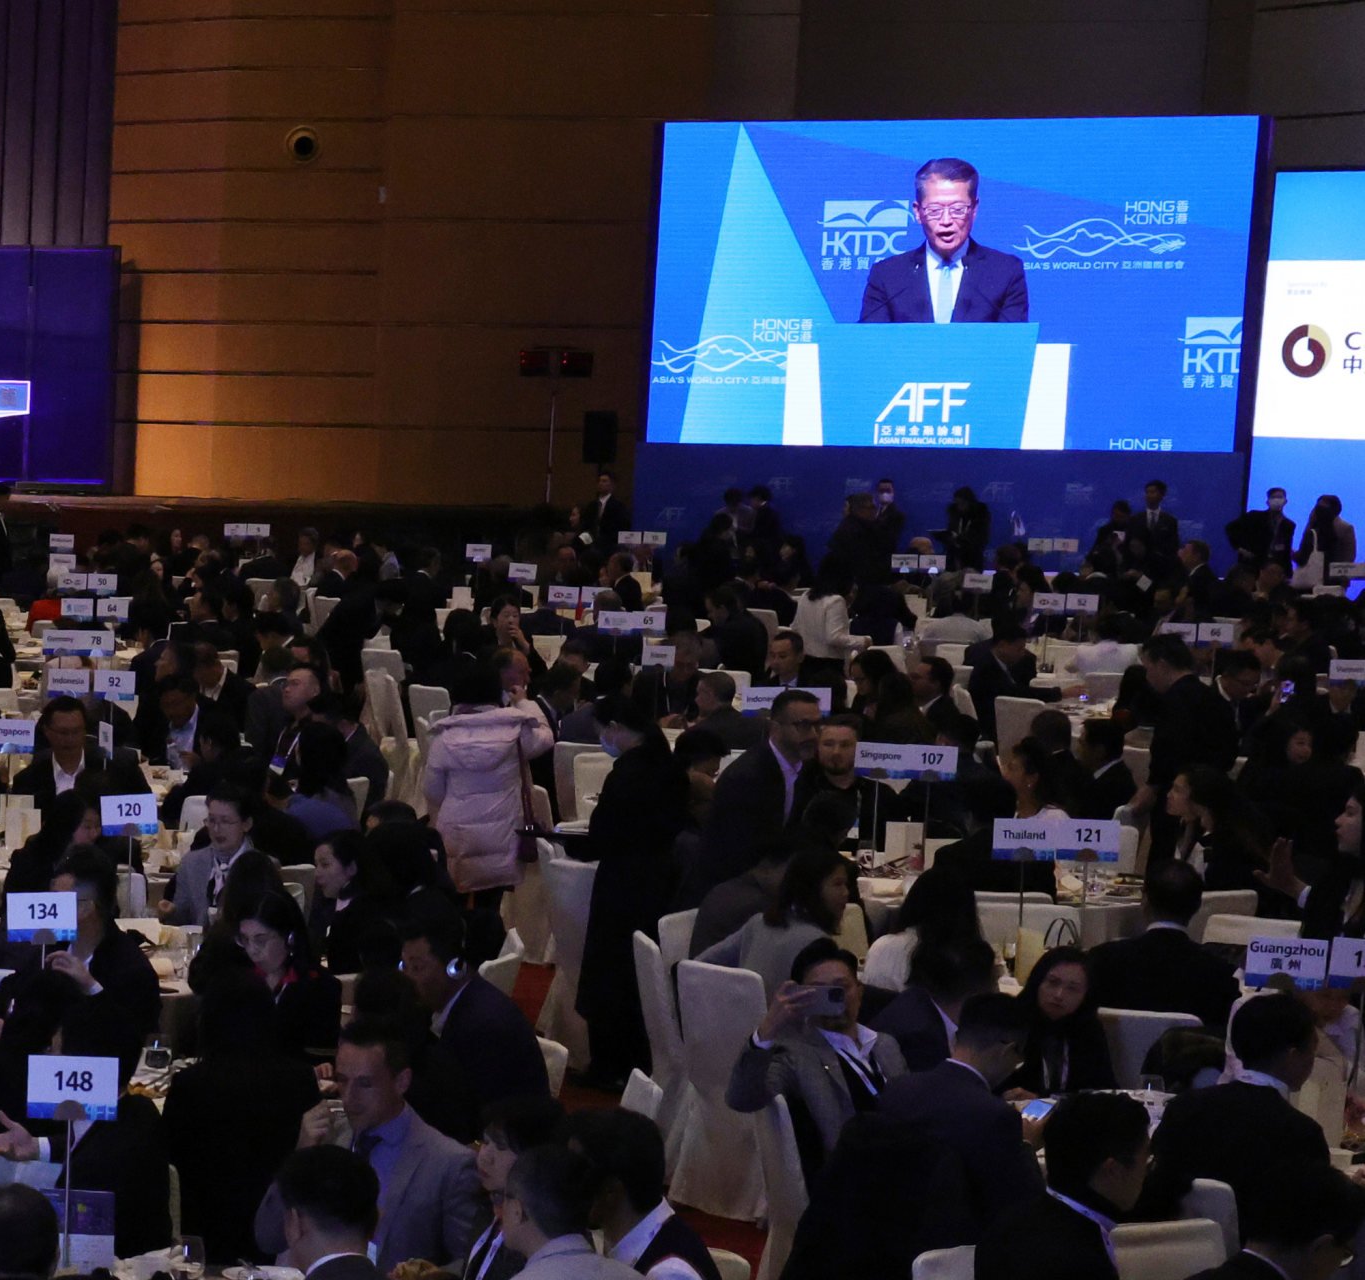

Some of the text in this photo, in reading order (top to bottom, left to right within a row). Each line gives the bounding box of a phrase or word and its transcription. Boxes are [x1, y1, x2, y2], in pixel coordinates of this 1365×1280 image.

[1125, 200, 1175, 212] HONG
[1124, 213, 1175, 225] KONG
[822, 231, 907, 256] HKTDC
[1052, 262, 1119, 270] WORLD CITY
[753, 318, 799, 331] HONG
[753, 331, 799, 343] KONG
[652, 376, 749, 384] ASIA'S WORLD CITY
[875, 382, 971, 423] AFF
[879, 437, 964, 446] ASIAN FINANCIAL FORUM
[1110, 439, 1158, 451] HONG
[98, 577, 108, 586] 50
[106, 604, 117, 613] 64
[1210, 628, 1221, 637] 66
[90, 636, 102, 646] 78
[51, 676, 121, 688] Indonesia 92
[860, 750, 944, 765] Singapore 107
[116, 803, 141, 817] 120
[1002, 828, 1101, 843] Thailand 121
[27, 902, 58, 920] 134
[1249, 941, 1325, 959] Guangzhou
[53, 1070, 94, 1093] 148
